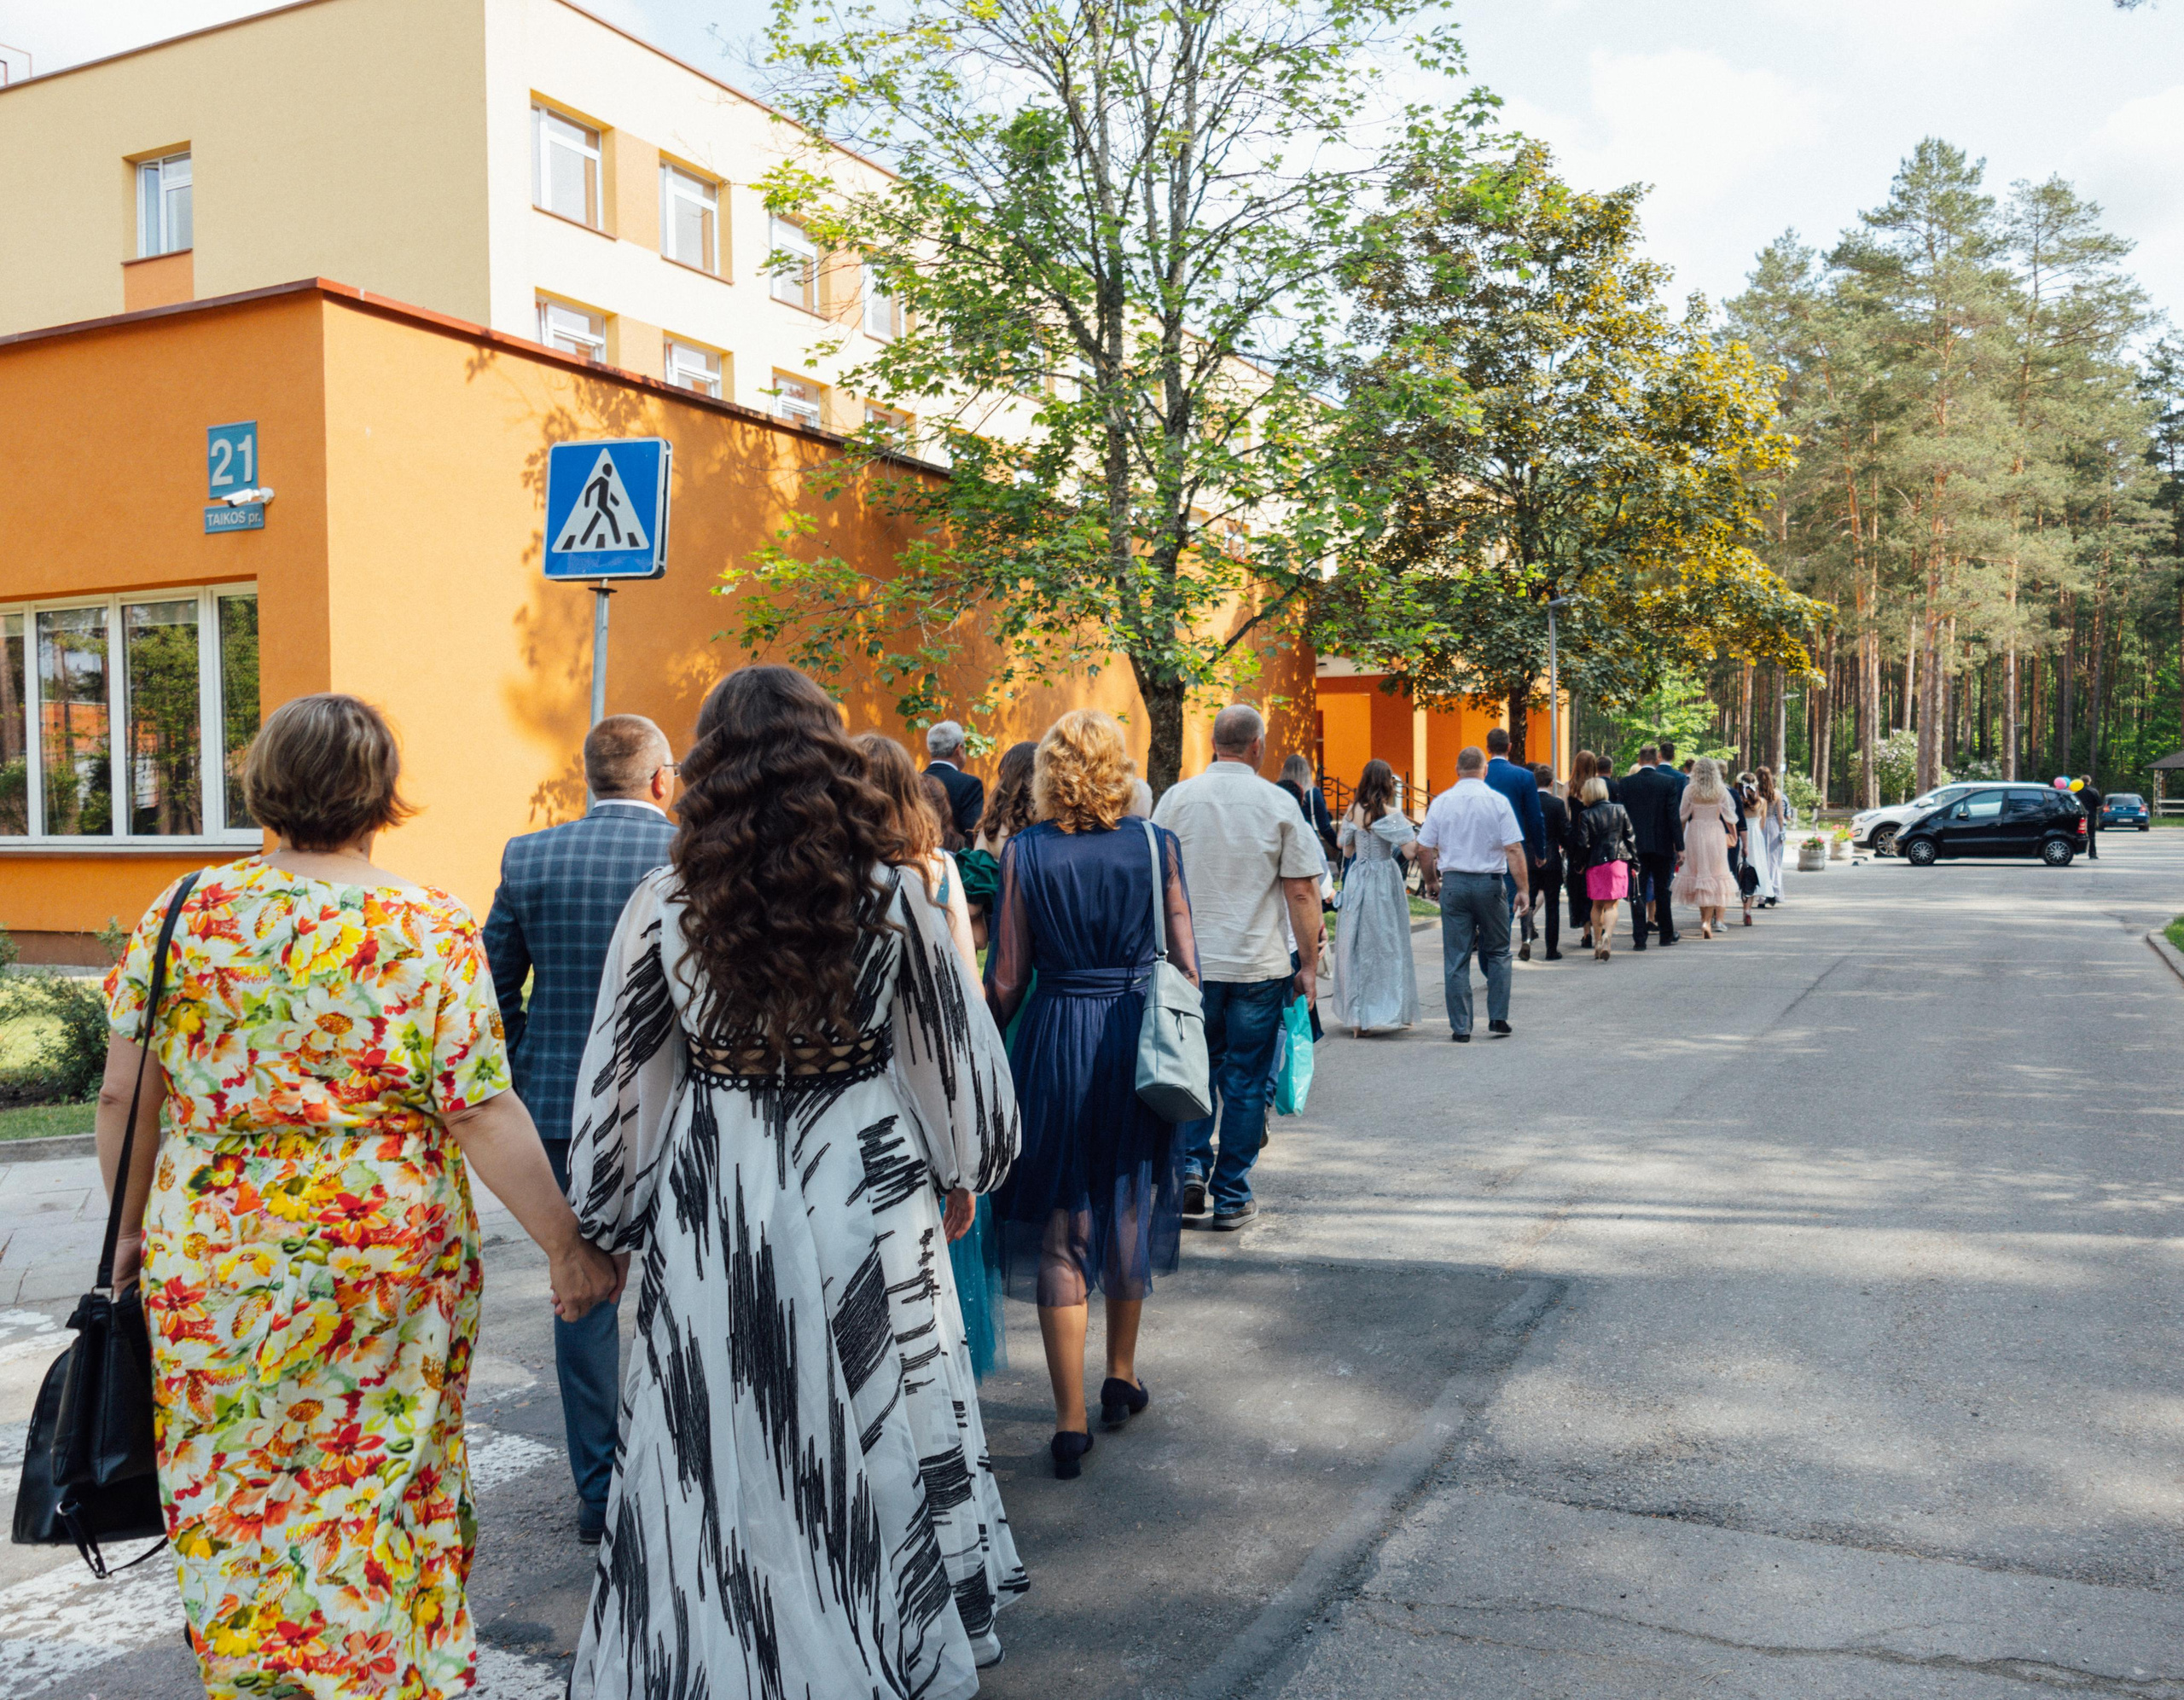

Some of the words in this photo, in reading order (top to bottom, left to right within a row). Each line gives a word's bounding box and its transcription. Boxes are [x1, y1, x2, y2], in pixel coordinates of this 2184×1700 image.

[211, 434, 253, 486] 21
[206, 510, 246, 526] TAIKOS
[248, 513, 261, 525] pr.
